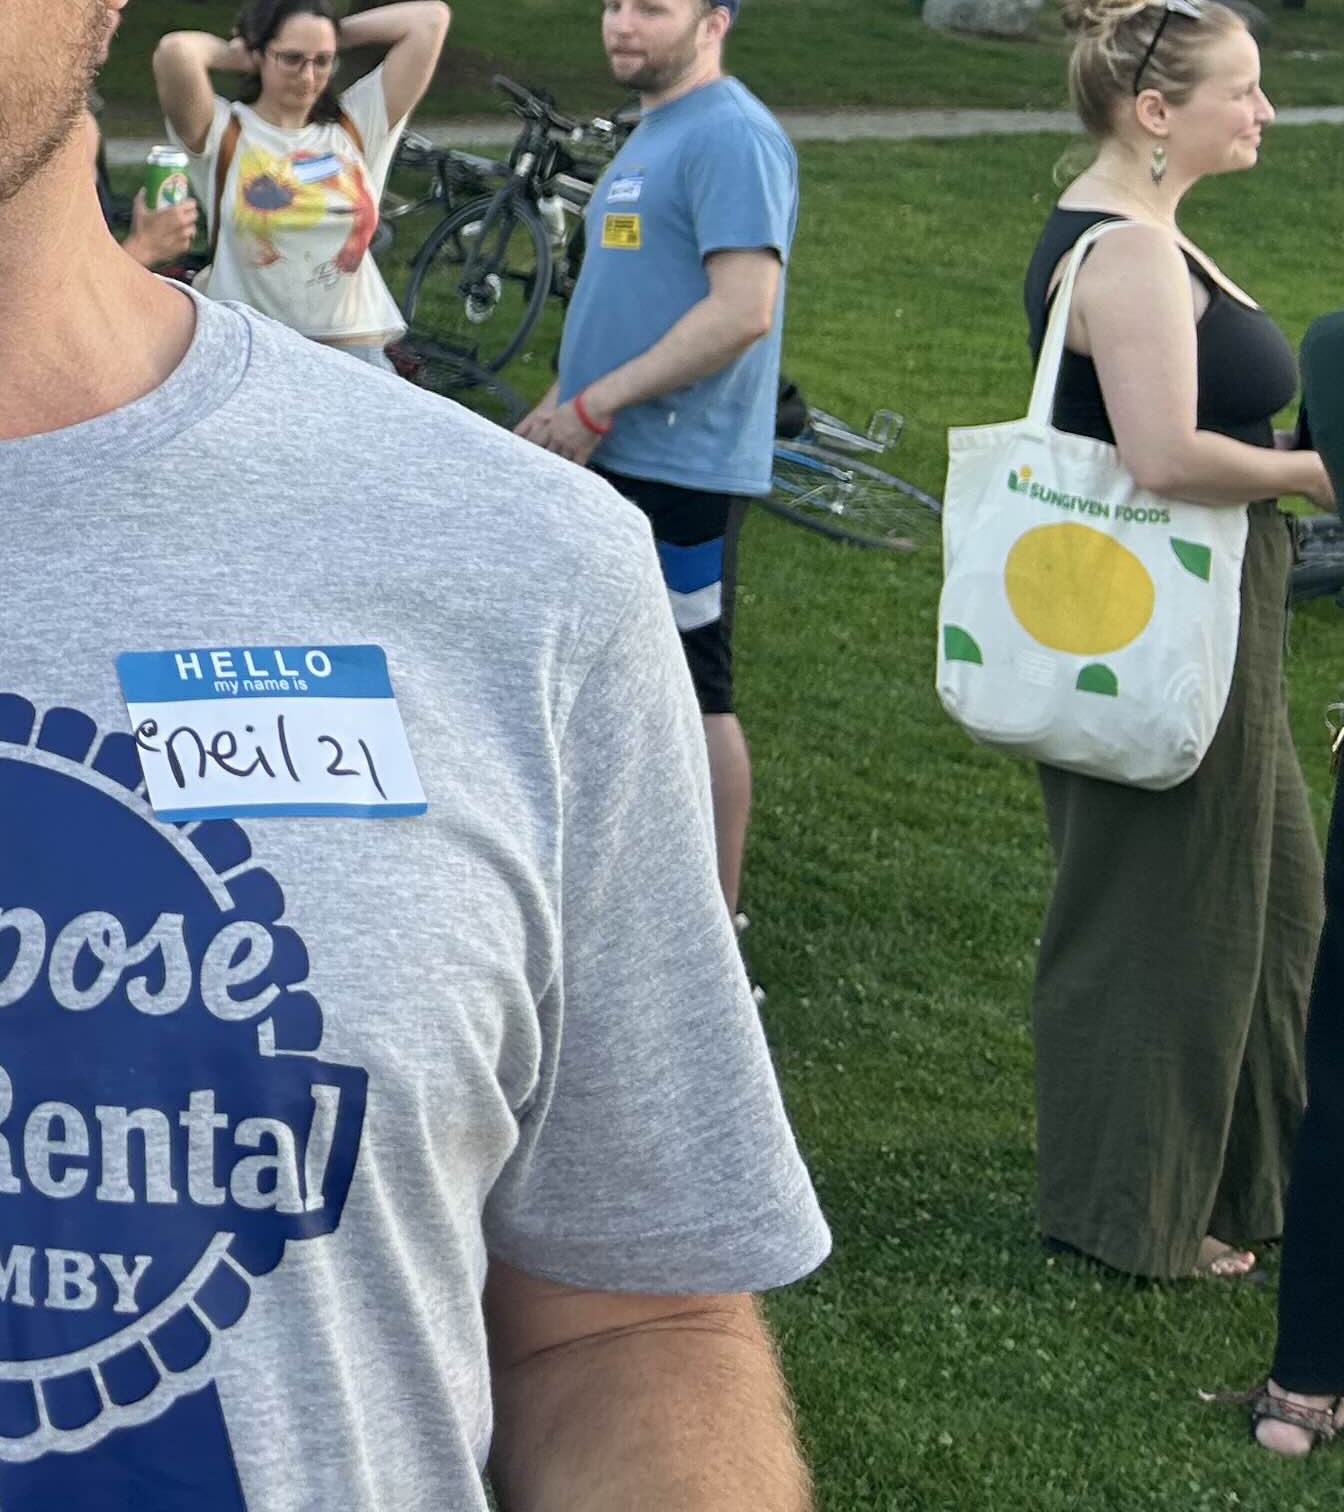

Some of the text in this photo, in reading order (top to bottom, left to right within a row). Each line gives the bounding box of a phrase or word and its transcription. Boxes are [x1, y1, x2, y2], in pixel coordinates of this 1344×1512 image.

[1029, 481, 1171, 524] SUNGIVEN FOODS
[174, 649, 333, 680] HELLO
[214, 676, 309, 695] my name is
